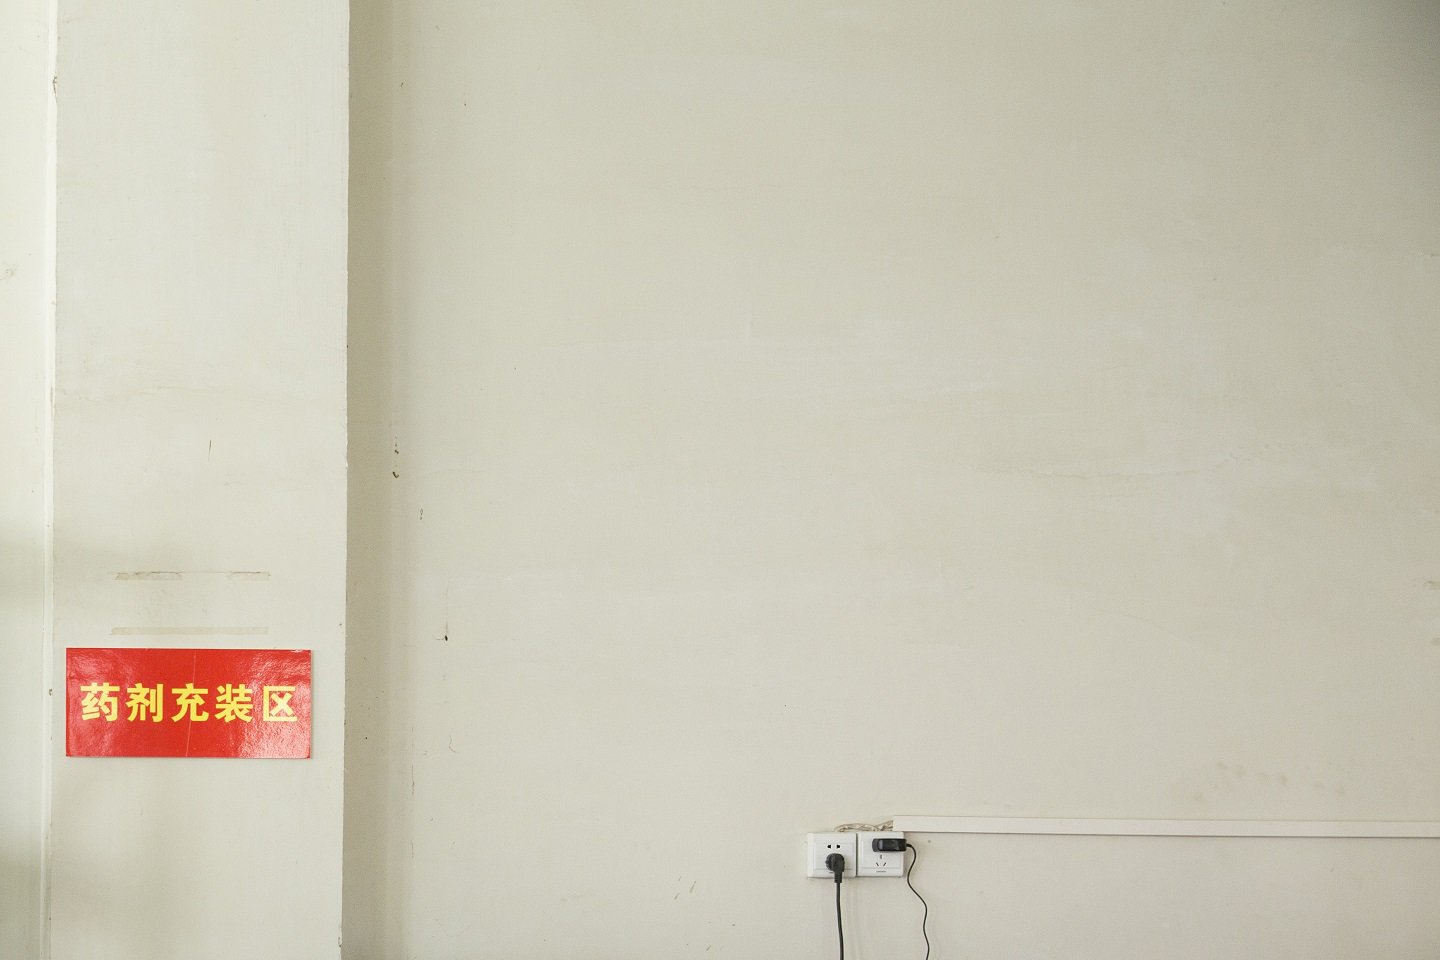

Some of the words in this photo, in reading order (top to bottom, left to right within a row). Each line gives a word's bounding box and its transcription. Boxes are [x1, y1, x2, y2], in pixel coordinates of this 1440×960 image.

[79, 682, 298, 723] 药剂充装区
